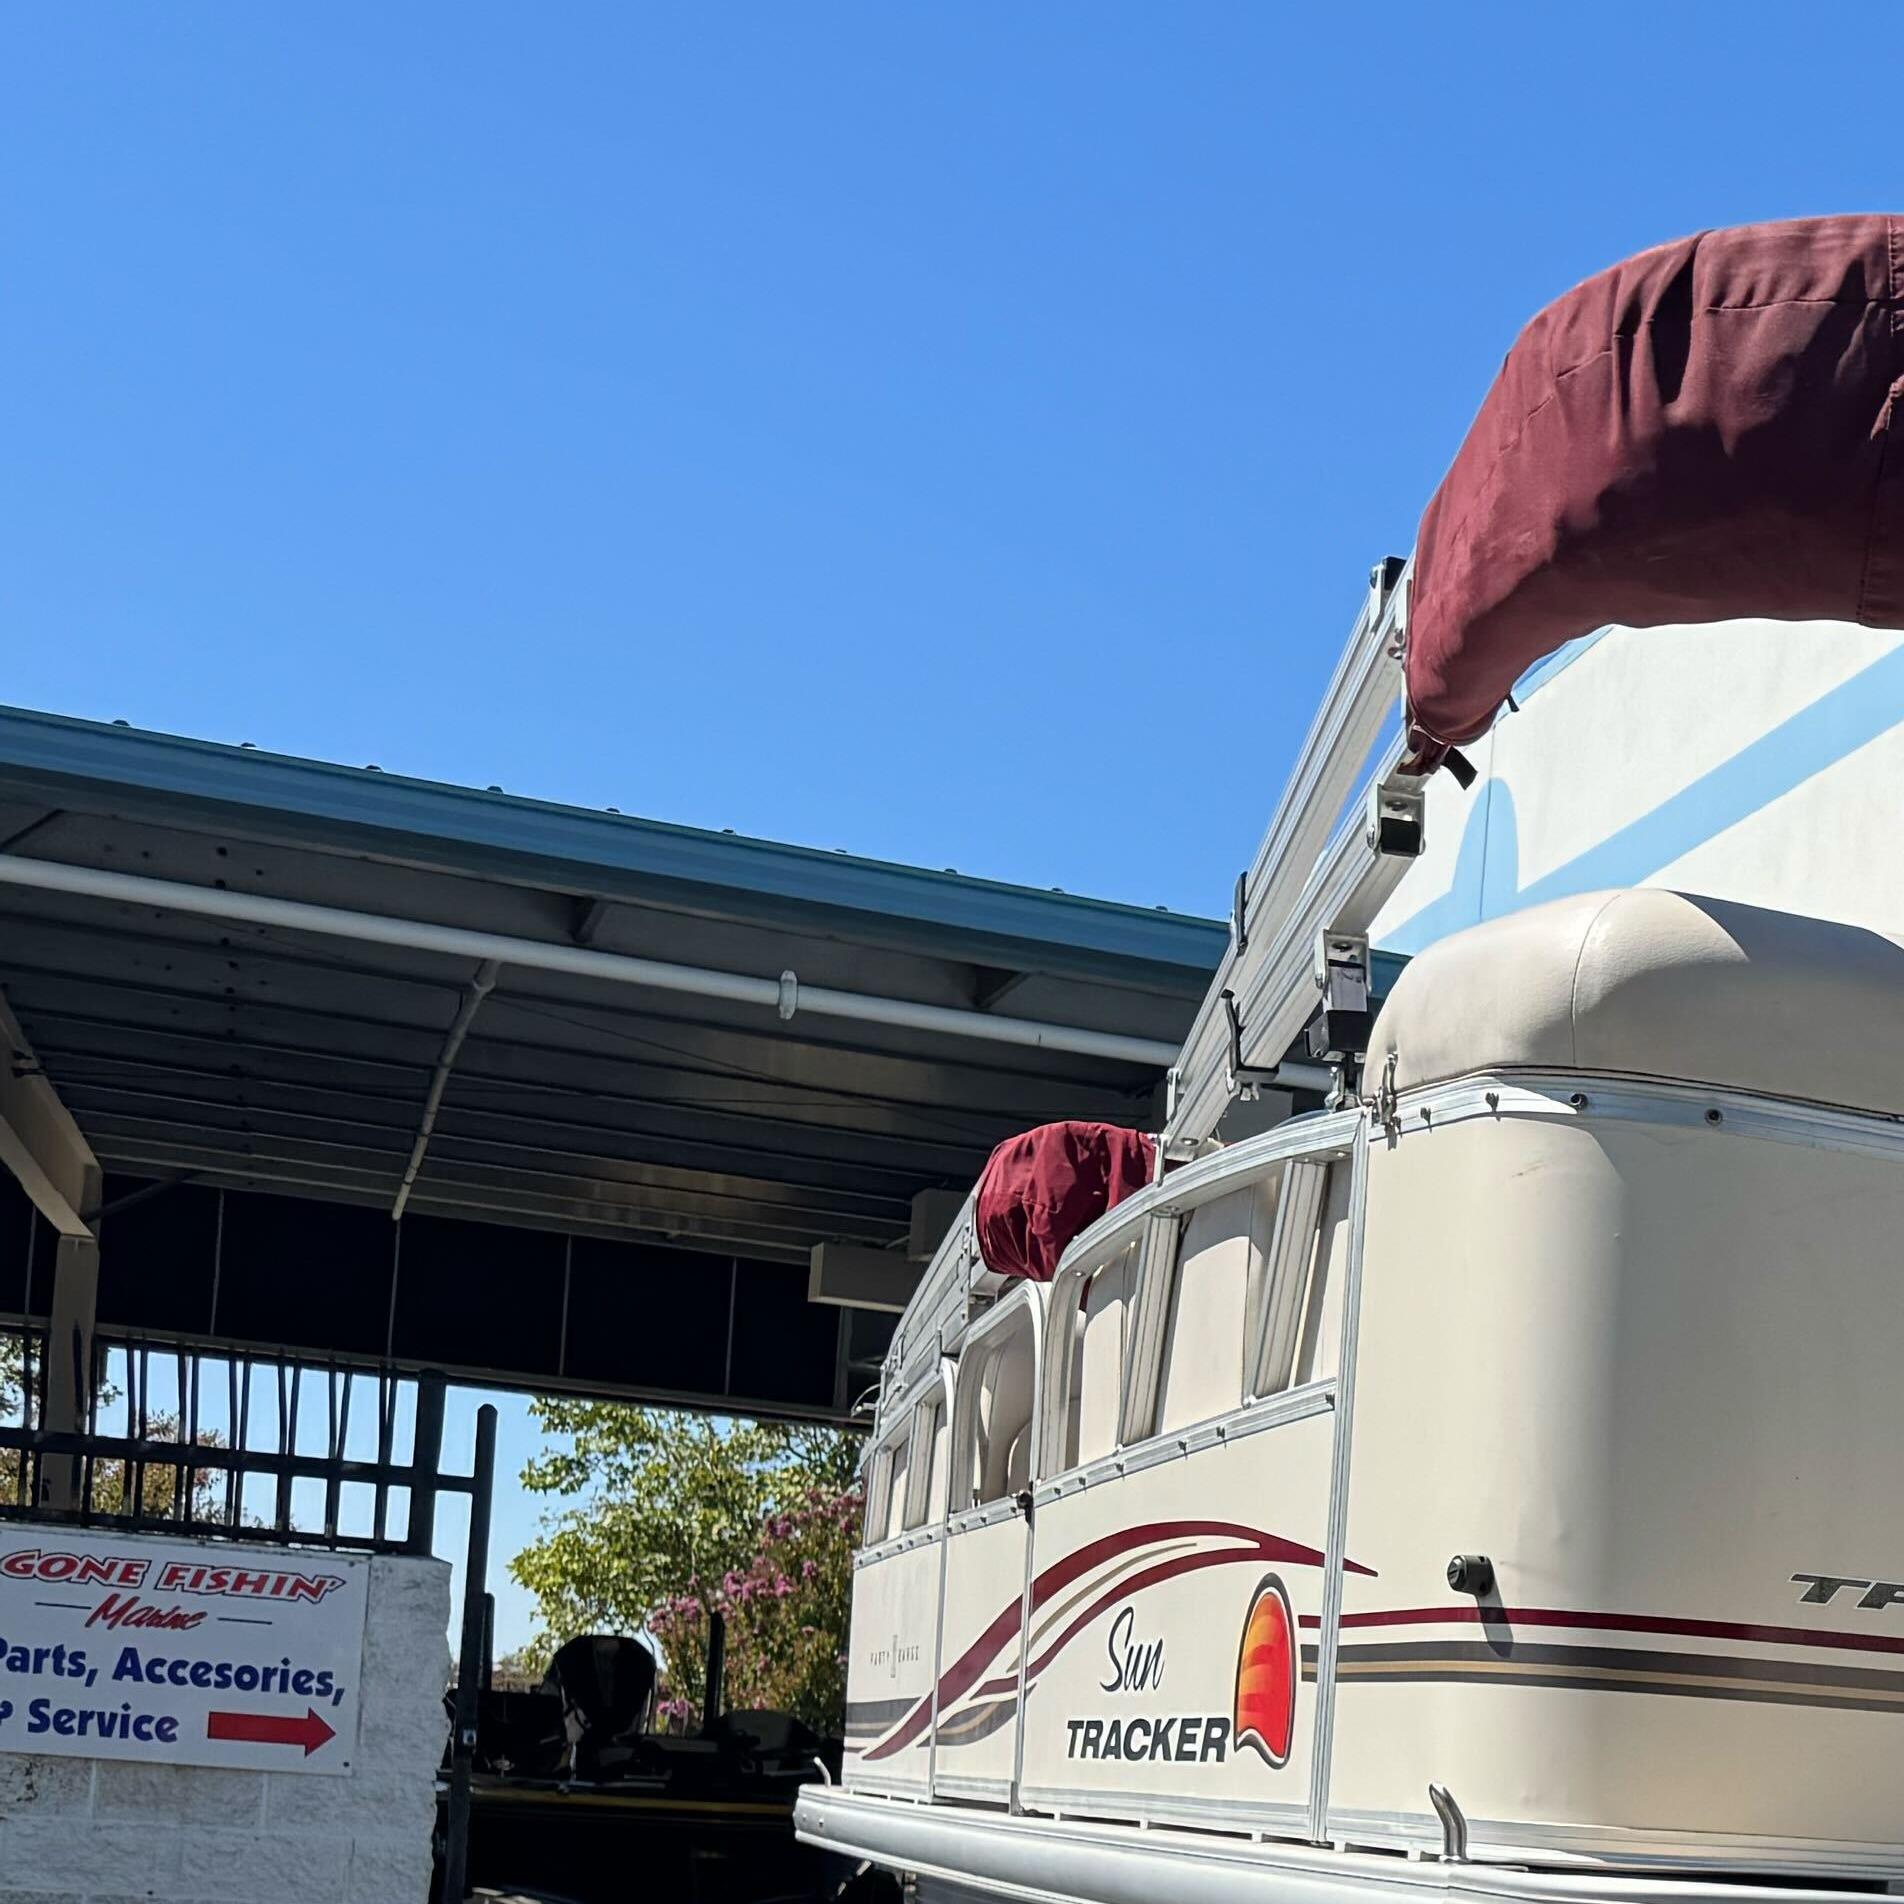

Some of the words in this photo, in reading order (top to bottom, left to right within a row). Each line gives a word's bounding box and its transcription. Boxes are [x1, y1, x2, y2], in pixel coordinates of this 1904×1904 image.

[1, 1549, 151, 1588] GONE
[155, 1561, 347, 1604] FISHIN'
[112, 1647, 345, 1706] Accesories,
[1100, 1606, 1165, 1692] Sun
[27, 1698, 179, 1743] Service
[1067, 1716, 1231, 1763] TRACKER
